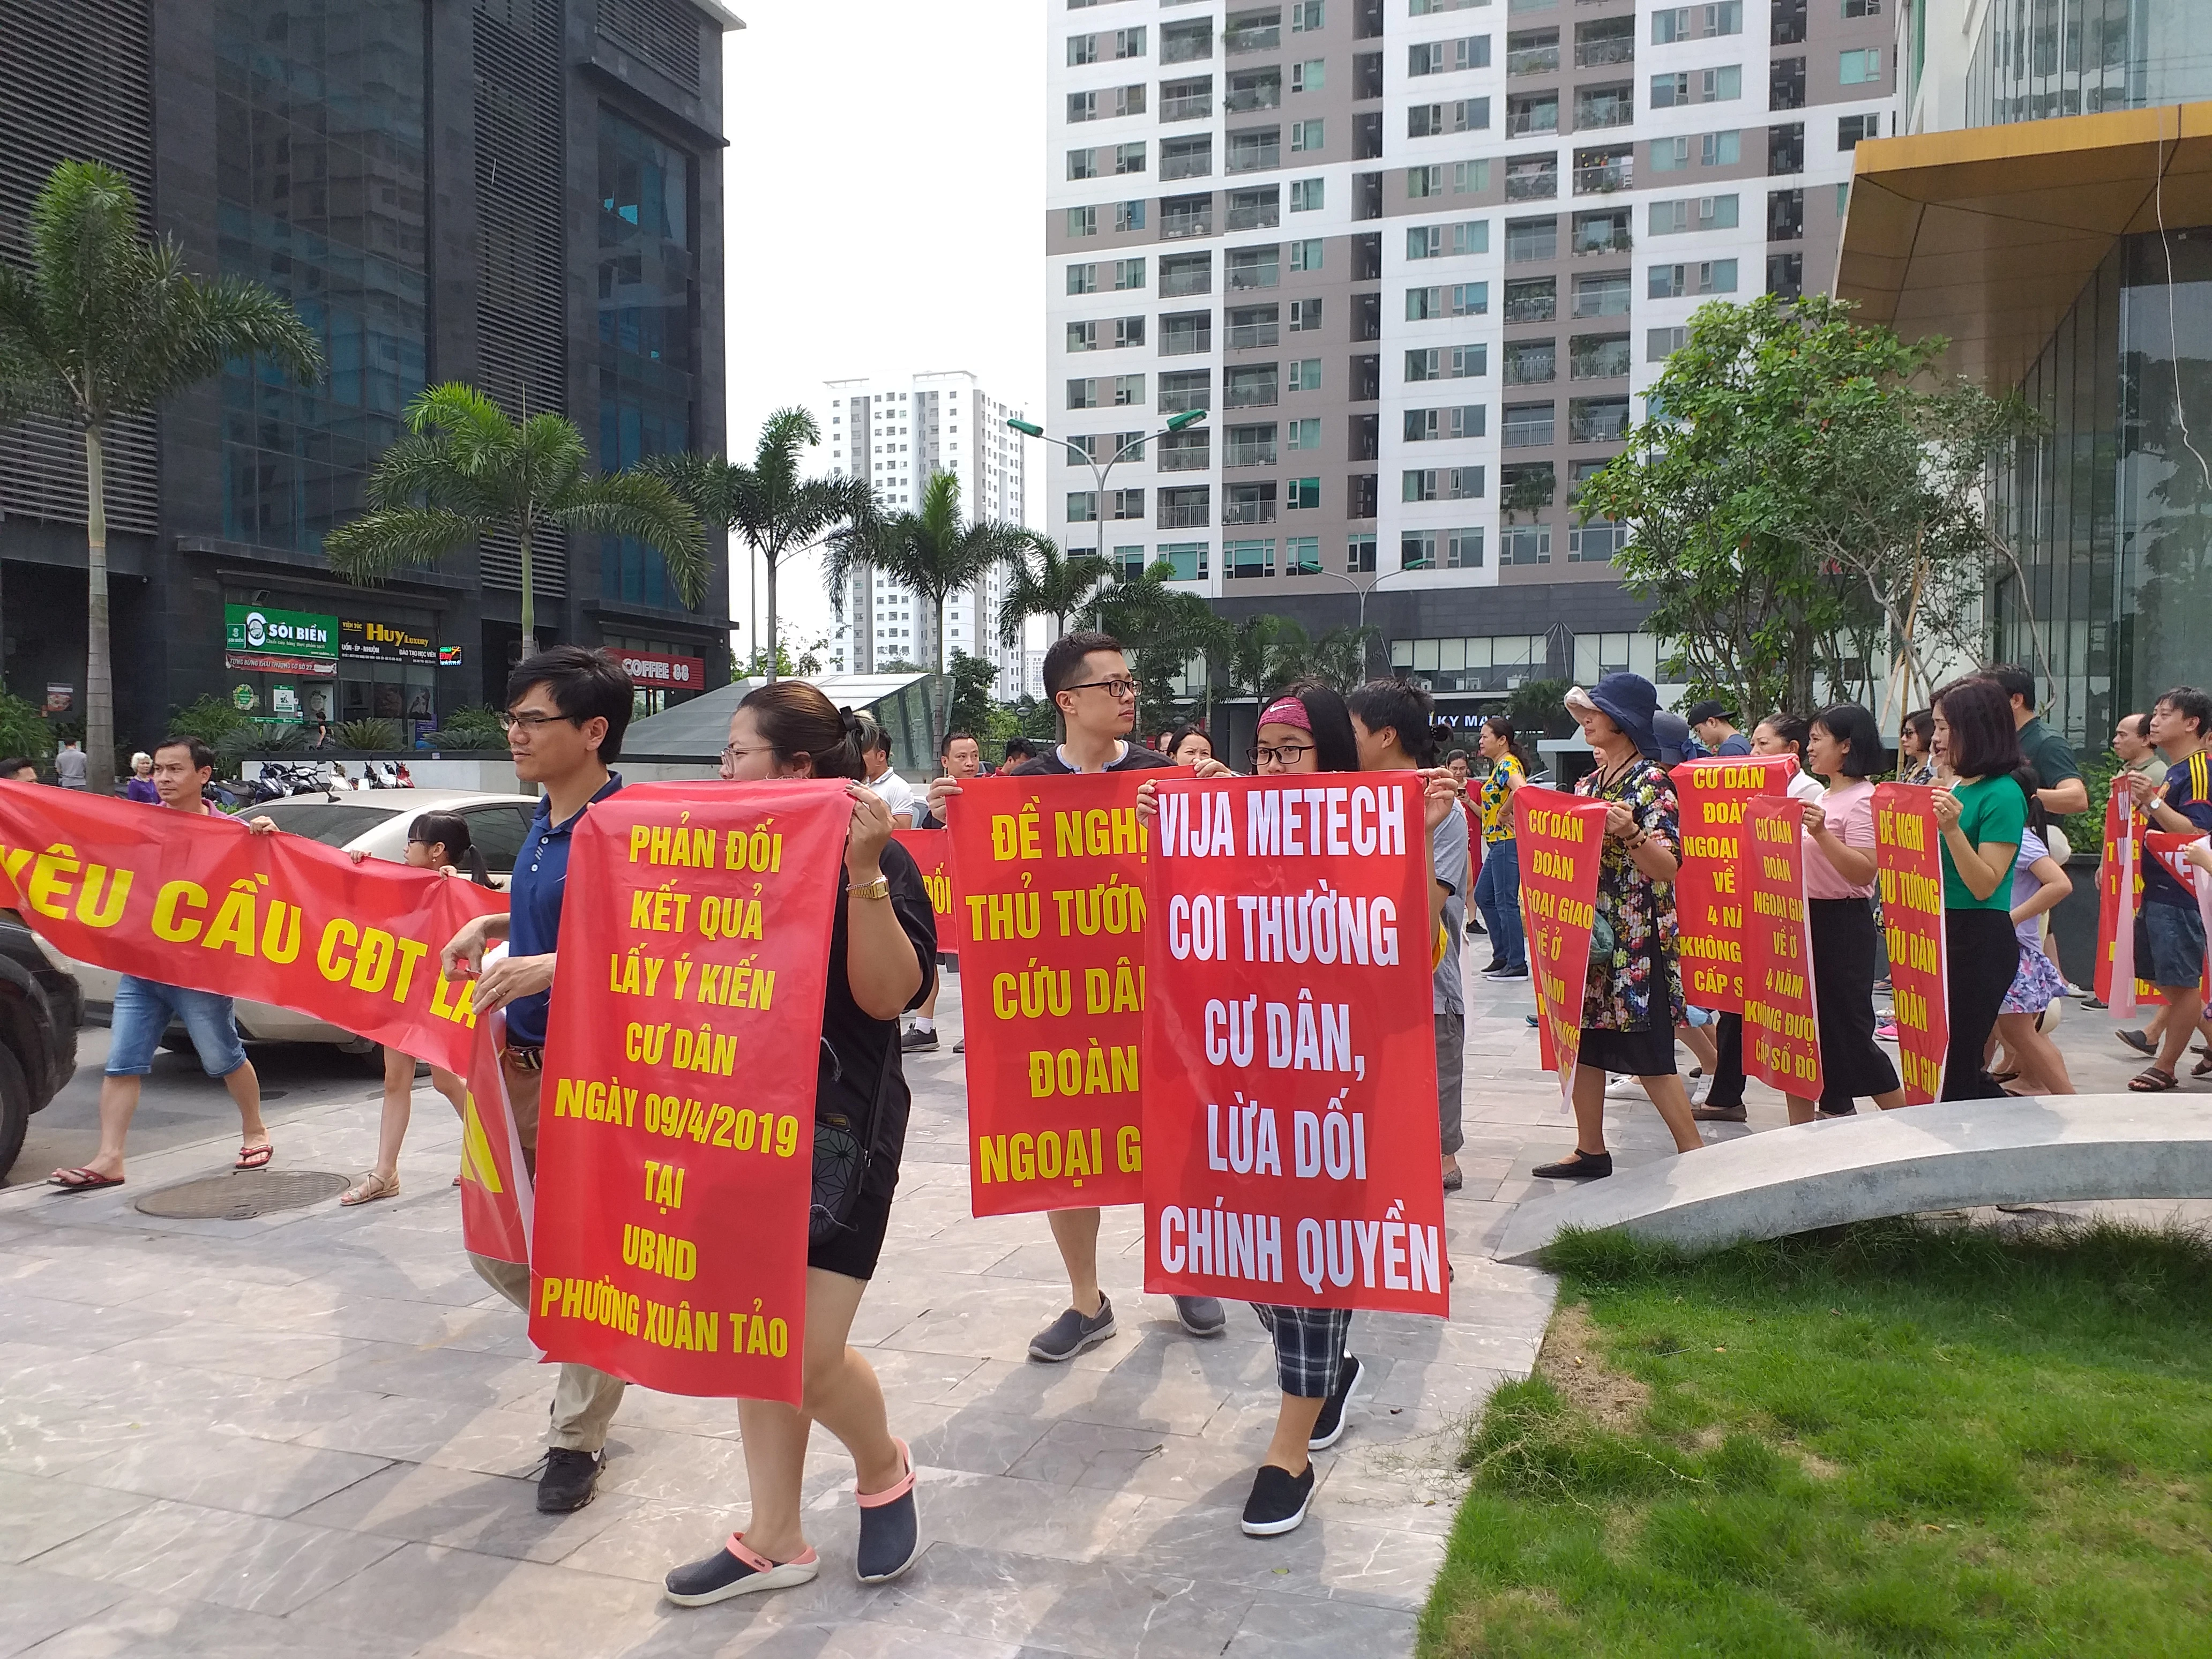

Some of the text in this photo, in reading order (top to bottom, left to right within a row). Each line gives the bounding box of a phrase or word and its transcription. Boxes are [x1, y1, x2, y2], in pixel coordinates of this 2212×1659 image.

[296, 623, 327, 642] BIỂN
[622, 657, 689, 682] COFFEE 88
[1693, 764, 1766, 789] CƯ DÂN
[629, 811, 783, 873] PHẢN ĐỐI
[991, 796, 1148, 864] ĐỀ NGHỊ
[1158, 785, 1406, 857] VIJA METECH
[1528, 809, 1583, 843] CƯ DÂN
[1683, 835, 1738, 863] NGOẠI
[1755, 814, 1793, 845] CƯ DÂN
[1895, 812, 1925, 861] NGHỊ
[1533, 849, 1574, 882] ĐOÀN
[1712, 864, 1736, 894] VỀ
[1763, 853, 1792, 883] ĐOÀN
[1878, 854, 1940, 916] HỦ TƯỚNG
[0, 843, 134, 928] YÊU
[152, 872, 302, 964] CẦU
[317, 917, 428, 1004] CĐT
[630, 879, 763, 941] KẾT QUẢ
[965, 871, 1147, 941] THỦ TƯỚN
[1169, 879, 1400, 966] COI THƯỜNG
[1526, 887, 1594, 930] GOẠI GIAO
[1707, 905, 1718, 926] 4
[1753, 891, 1804, 923] NGOẠI GIA
[1551, 926, 1563, 961] Ở
[1679, 934, 1742, 963] KHÔNG
[1772, 925, 1797, 959] VỀ Ở
[1885, 917, 1937, 975] ỨU DÂN
[609, 942, 776, 1011] LẤY Ý KIẾN
[992, 956, 1146, 1020] CỨU DÂ
[1693, 966, 1743, 998] CẤP S
[1765, 967, 1804, 999] 4 NĂM
[625, 1021, 738, 1077] CƯ DÂN
[1205, 988, 1365, 1082] CƯ DÂN,
[1744, 999, 1817, 1047] KHÔNG ĐƯỢ
[1028, 1037, 1140, 1098] ĐOÀN
[1755, 1034, 1817, 1082] CẤP SỔ ĐỎ
[554, 1077, 799, 1158] NGÀY 09/4/2019
[1207, 1087, 1367, 1180] LỪA DỐI
[978, 1127, 1103, 1188] NGOẠI
[644, 1159, 686, 1215] TẠI
[622, 1223, 697, 1282] UBND
[1160, 1195, 1442, 1295] CHÍNH QUYỀN
[540, 1275, 788, 1358] PHƯỜNG XUÂN TẢO
